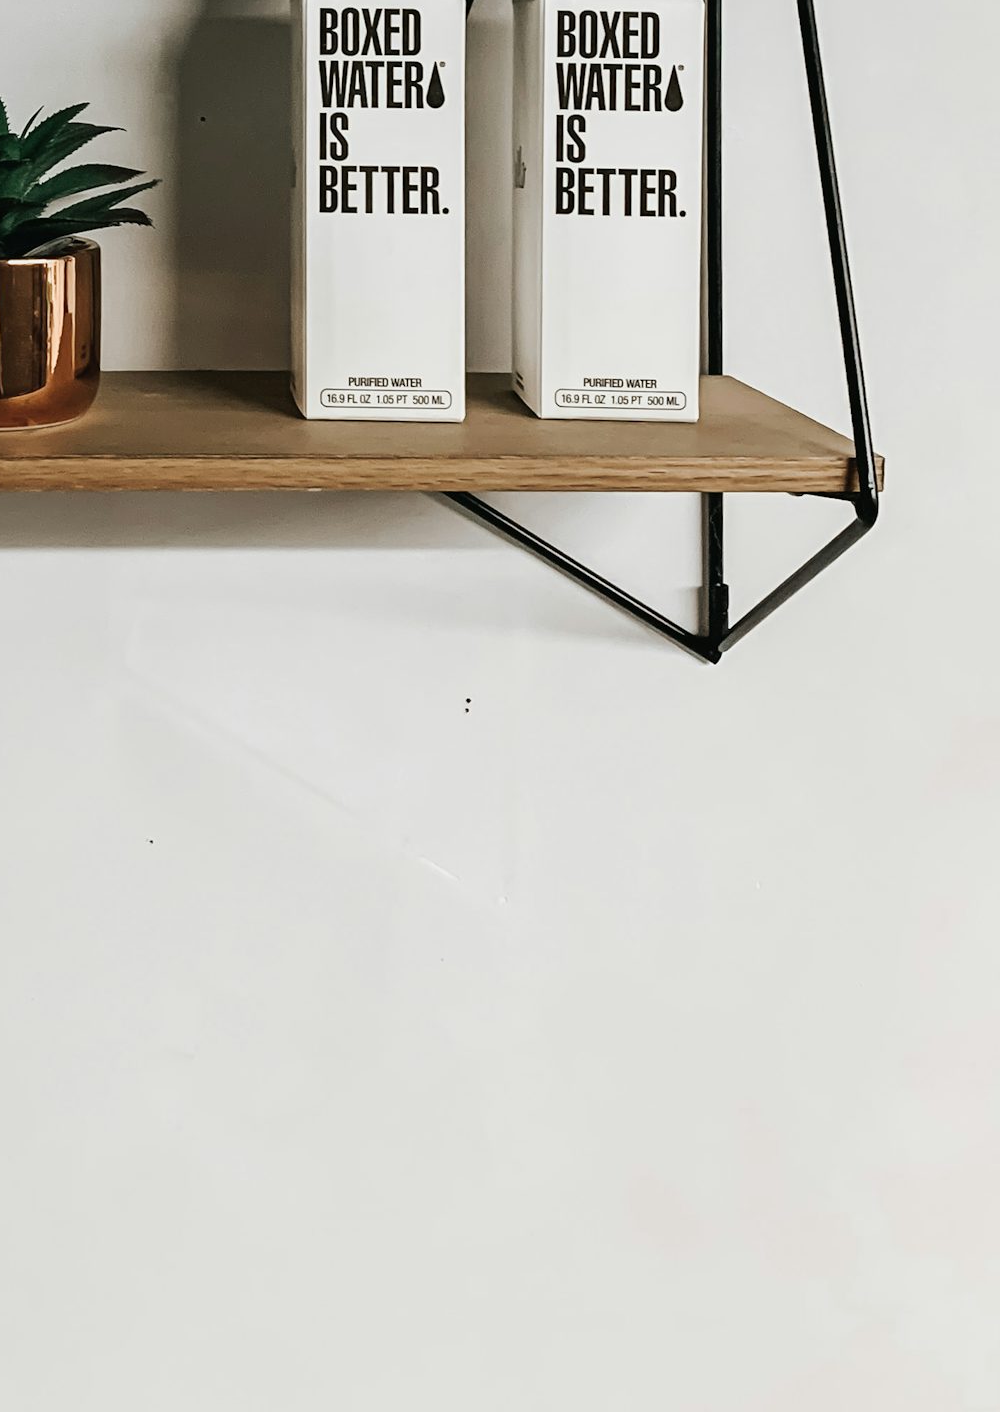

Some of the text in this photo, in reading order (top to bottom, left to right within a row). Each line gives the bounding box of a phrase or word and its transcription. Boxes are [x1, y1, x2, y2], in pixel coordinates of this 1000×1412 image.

[320, 7, 421, 56] BOXED
[557, 10, 660, 59] BOXED
[319, 60, 424, 108] WATER
[556, 63, 662, 111] WATER
[320, 112, 348, 161] IS
[556, 114, 586, 163] IS
[319, 165, 449, 214] BETTER.
[556, 167, 686, 217] BETTER.
[327, 394, 445, 405] 16.9 FL OZ 1.05 PT 500 ML
[348, 377, 422, 388] PURIFIED WATER
[561, 394, 680, 406] 16.9 FL OZ 1.05 PT 500 ML
[583, 378, 657, 388] PURIFIED WATER
